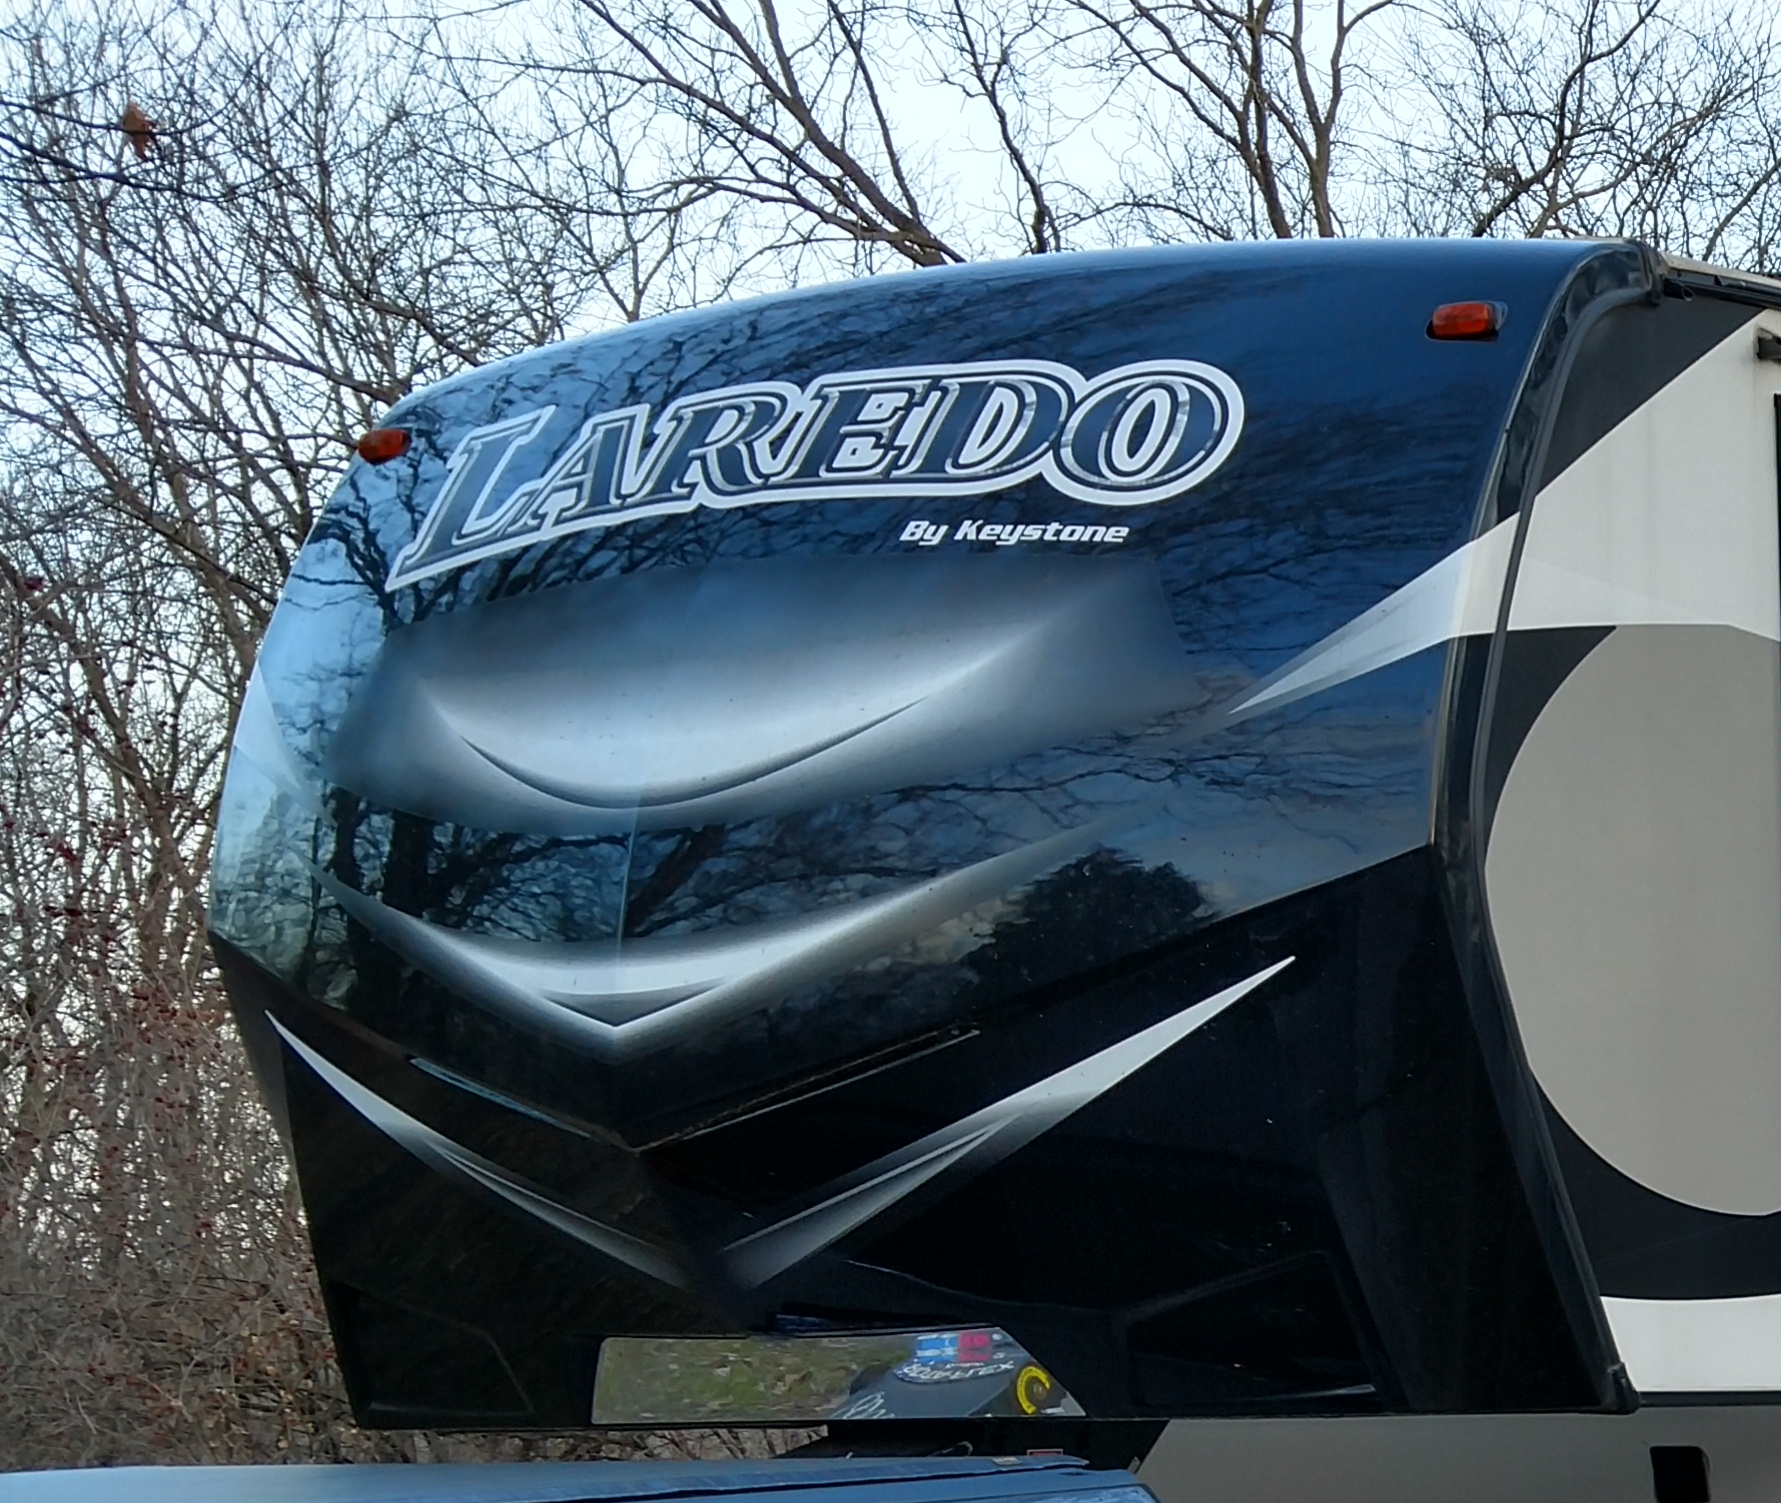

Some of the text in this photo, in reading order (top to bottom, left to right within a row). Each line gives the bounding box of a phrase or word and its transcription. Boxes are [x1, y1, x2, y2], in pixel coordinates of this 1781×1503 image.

[386, 358, 1244, 590] LAREDO
[900, 519, 1130, 545] By Keystone
